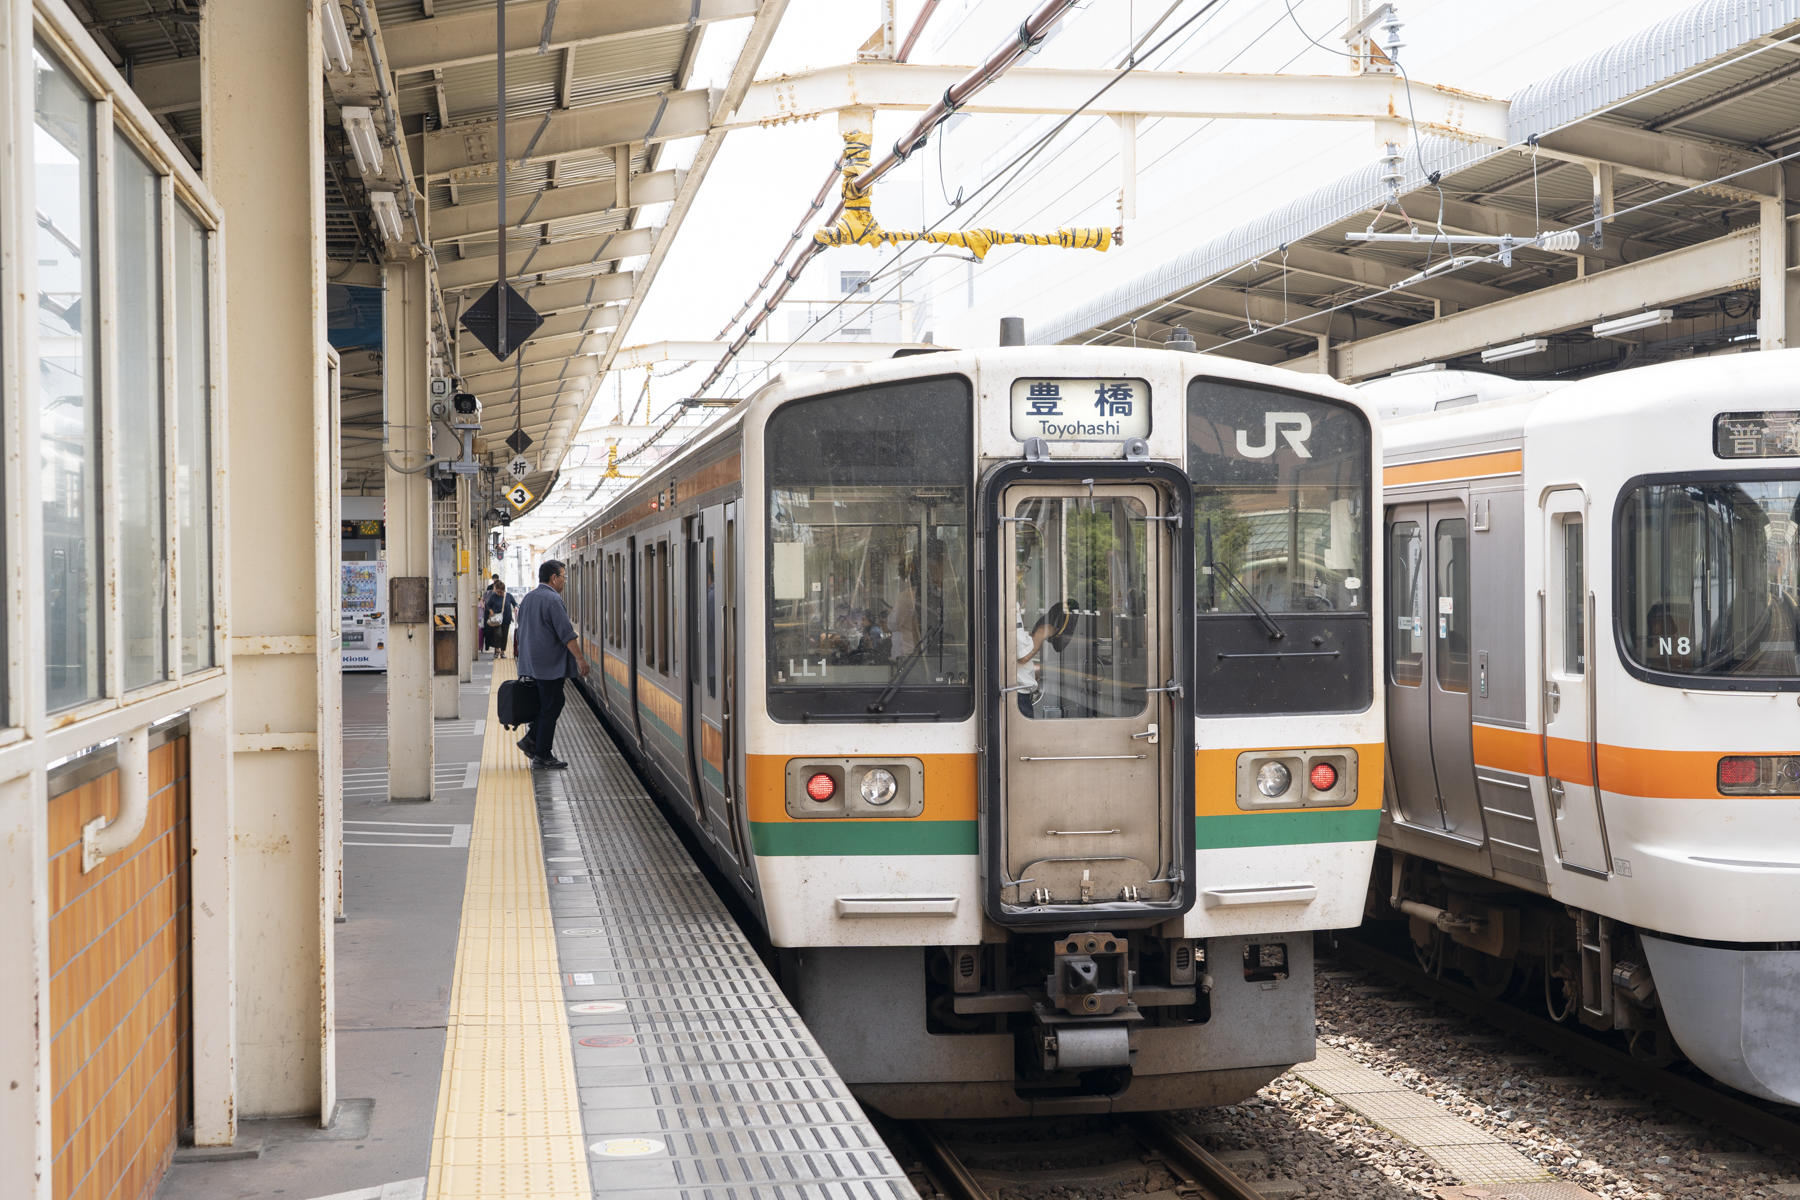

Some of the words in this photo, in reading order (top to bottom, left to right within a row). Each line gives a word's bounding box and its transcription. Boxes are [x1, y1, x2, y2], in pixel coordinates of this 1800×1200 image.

[1026, 382, 1133, 417] 豊橋
[1039, 420, 1120, 439] Toyohashi
[1236, 411, 1312, 459] JR
[513, 461, 527, 475] 折
[513, 488, 526, 504] 3
[1659, 636, 1691, 656] N8
[789, 658, 826, 677] LL1
